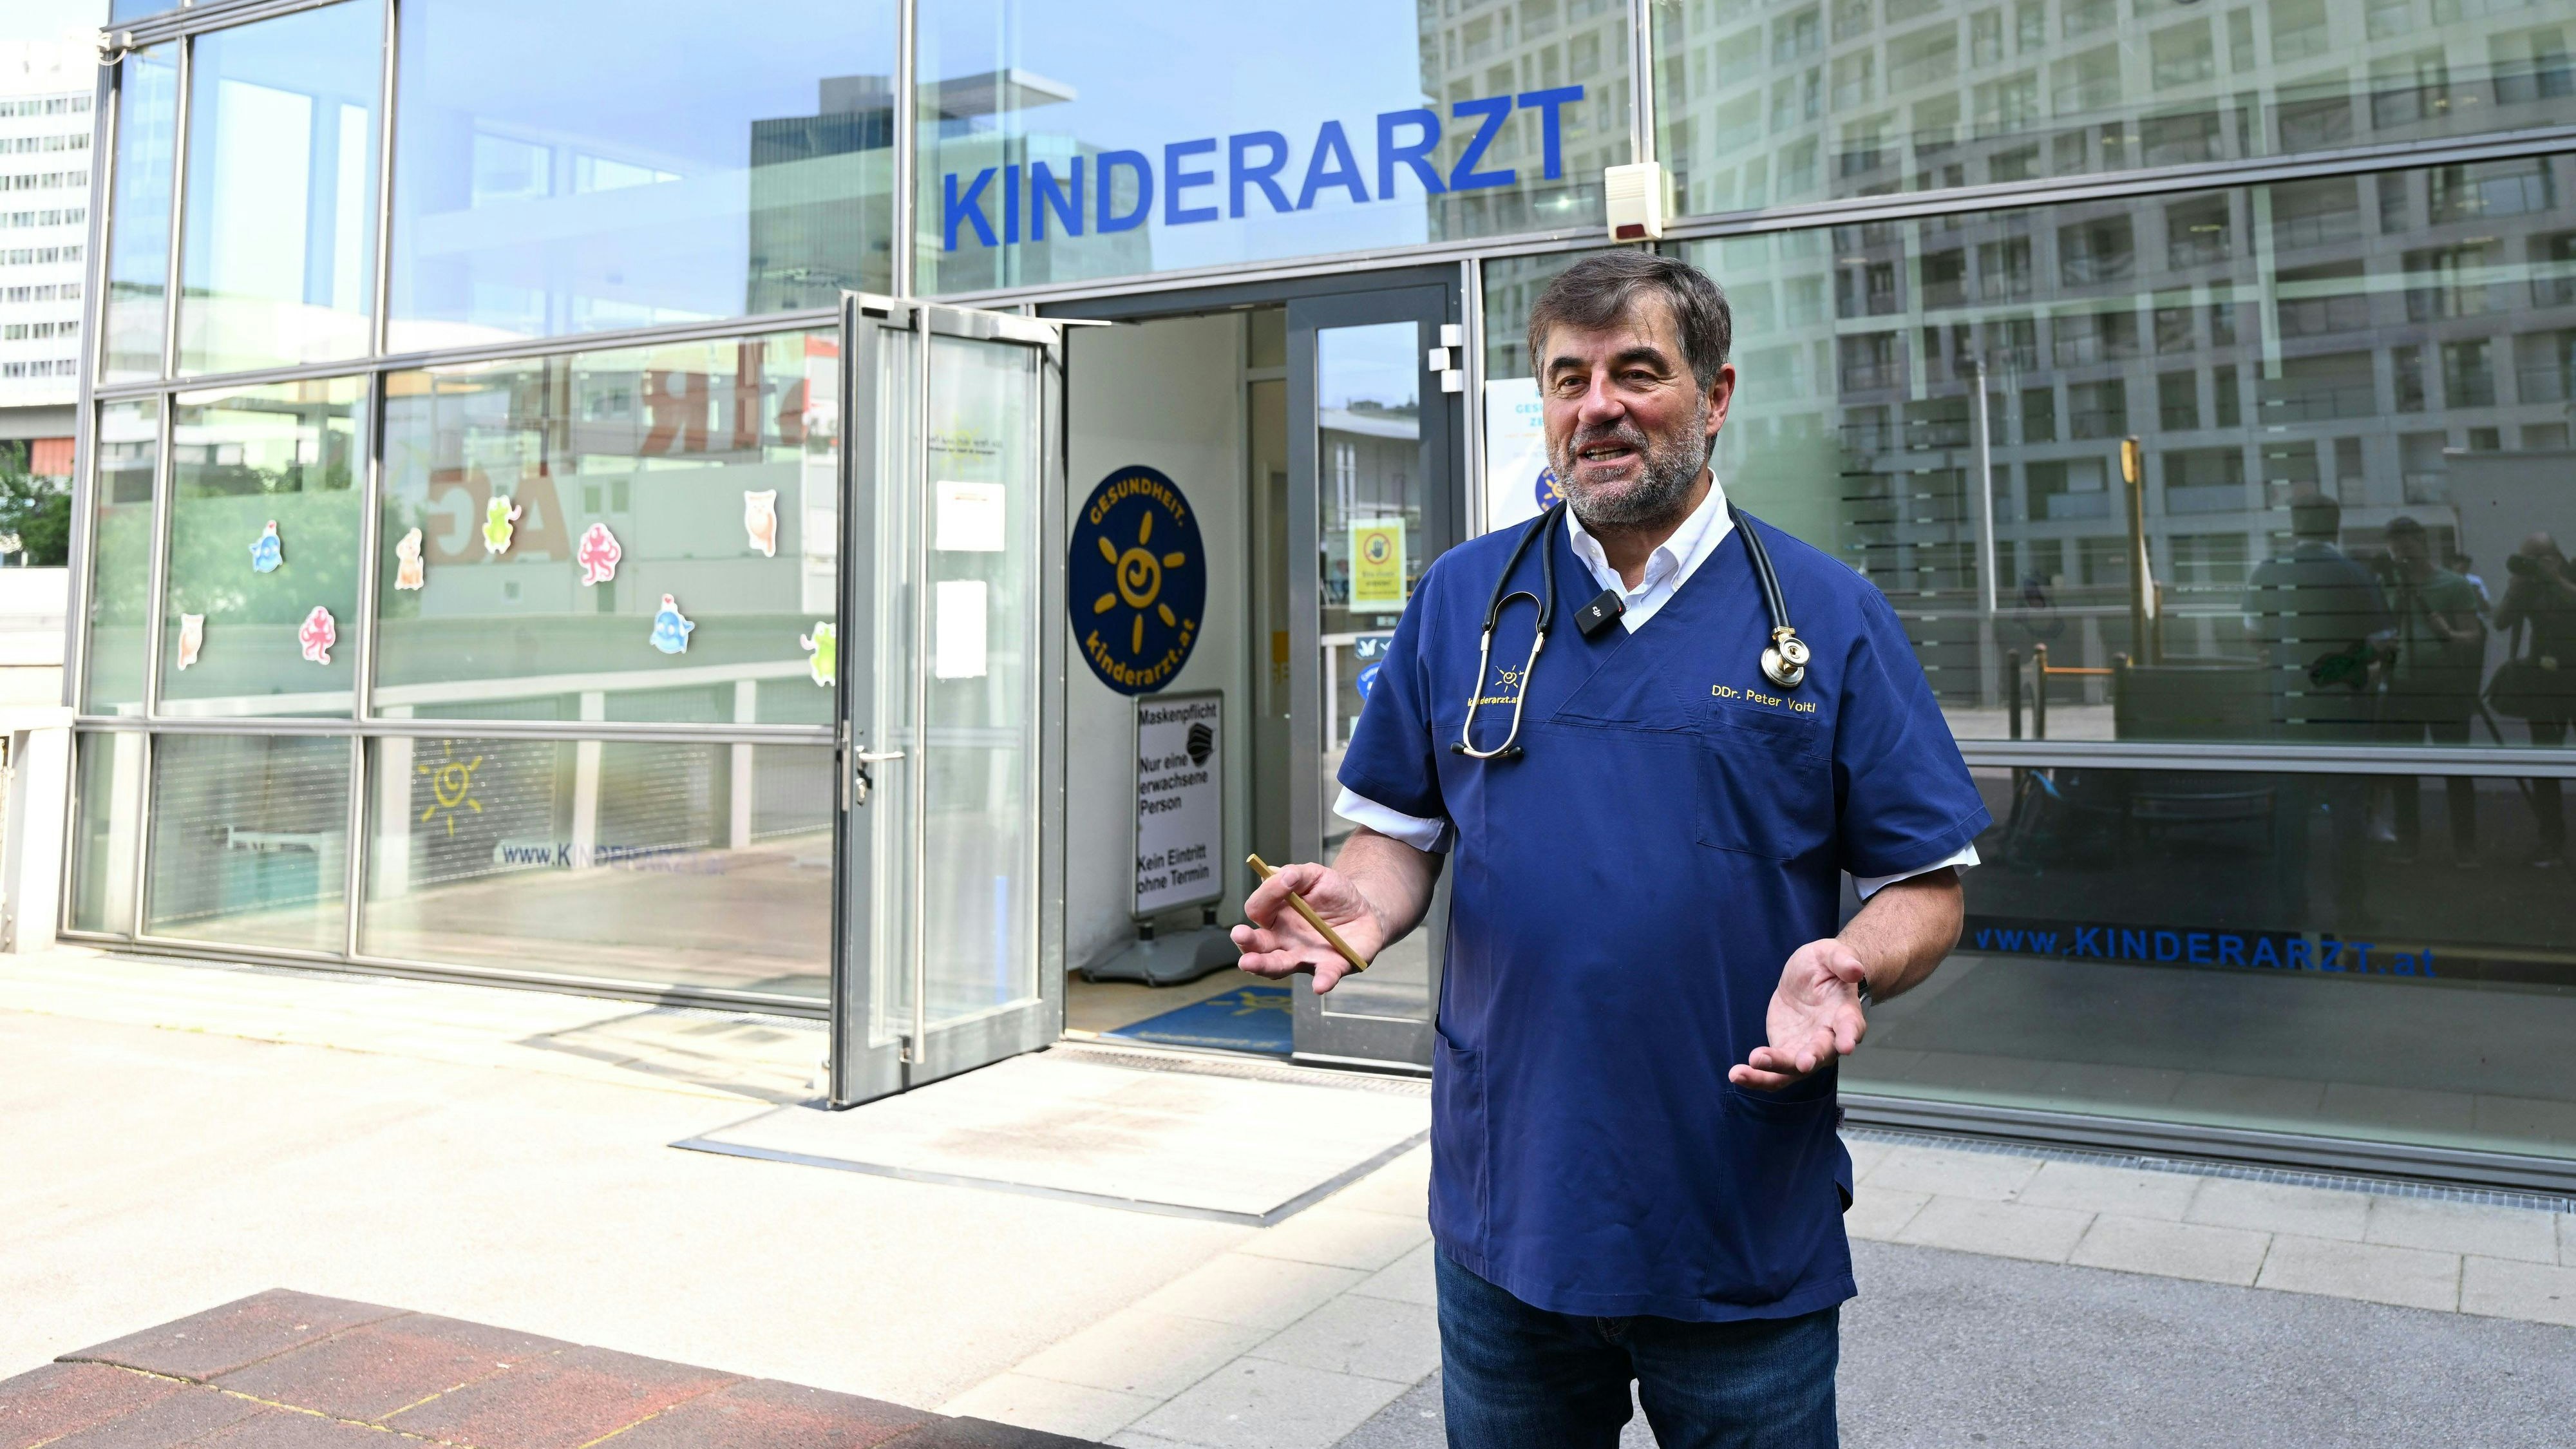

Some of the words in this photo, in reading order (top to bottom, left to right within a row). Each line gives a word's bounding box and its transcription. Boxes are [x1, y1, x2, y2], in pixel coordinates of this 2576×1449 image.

[944, 85, 1584, 252] KINDERARZT
[1090, 477, 1186, 526] GESUNDHEIT.
[1086, 618, 1195, 687] kinderarzt.at
[1712, 685, 1741, 699] DDr.
[1747, 689, 1782, 706] Peter
[1788, 697, 1816, 713] Voitl
[1139, 703, 1217, 726] Maskenpflicht
[1141, 757, 1161, 773] Nur
[1164, 752, 1188, 770] eine
[1141, 771, 1208, 795] erwachsene
[1140, 796, 1182, 816] Person
[1137, 853, 1165, 872] Kein
[1168, 844, 1206, 866] Eintritt
[1137, 876, 1168, 894] ohne
[1171, 863, 1209, 886] Termin
